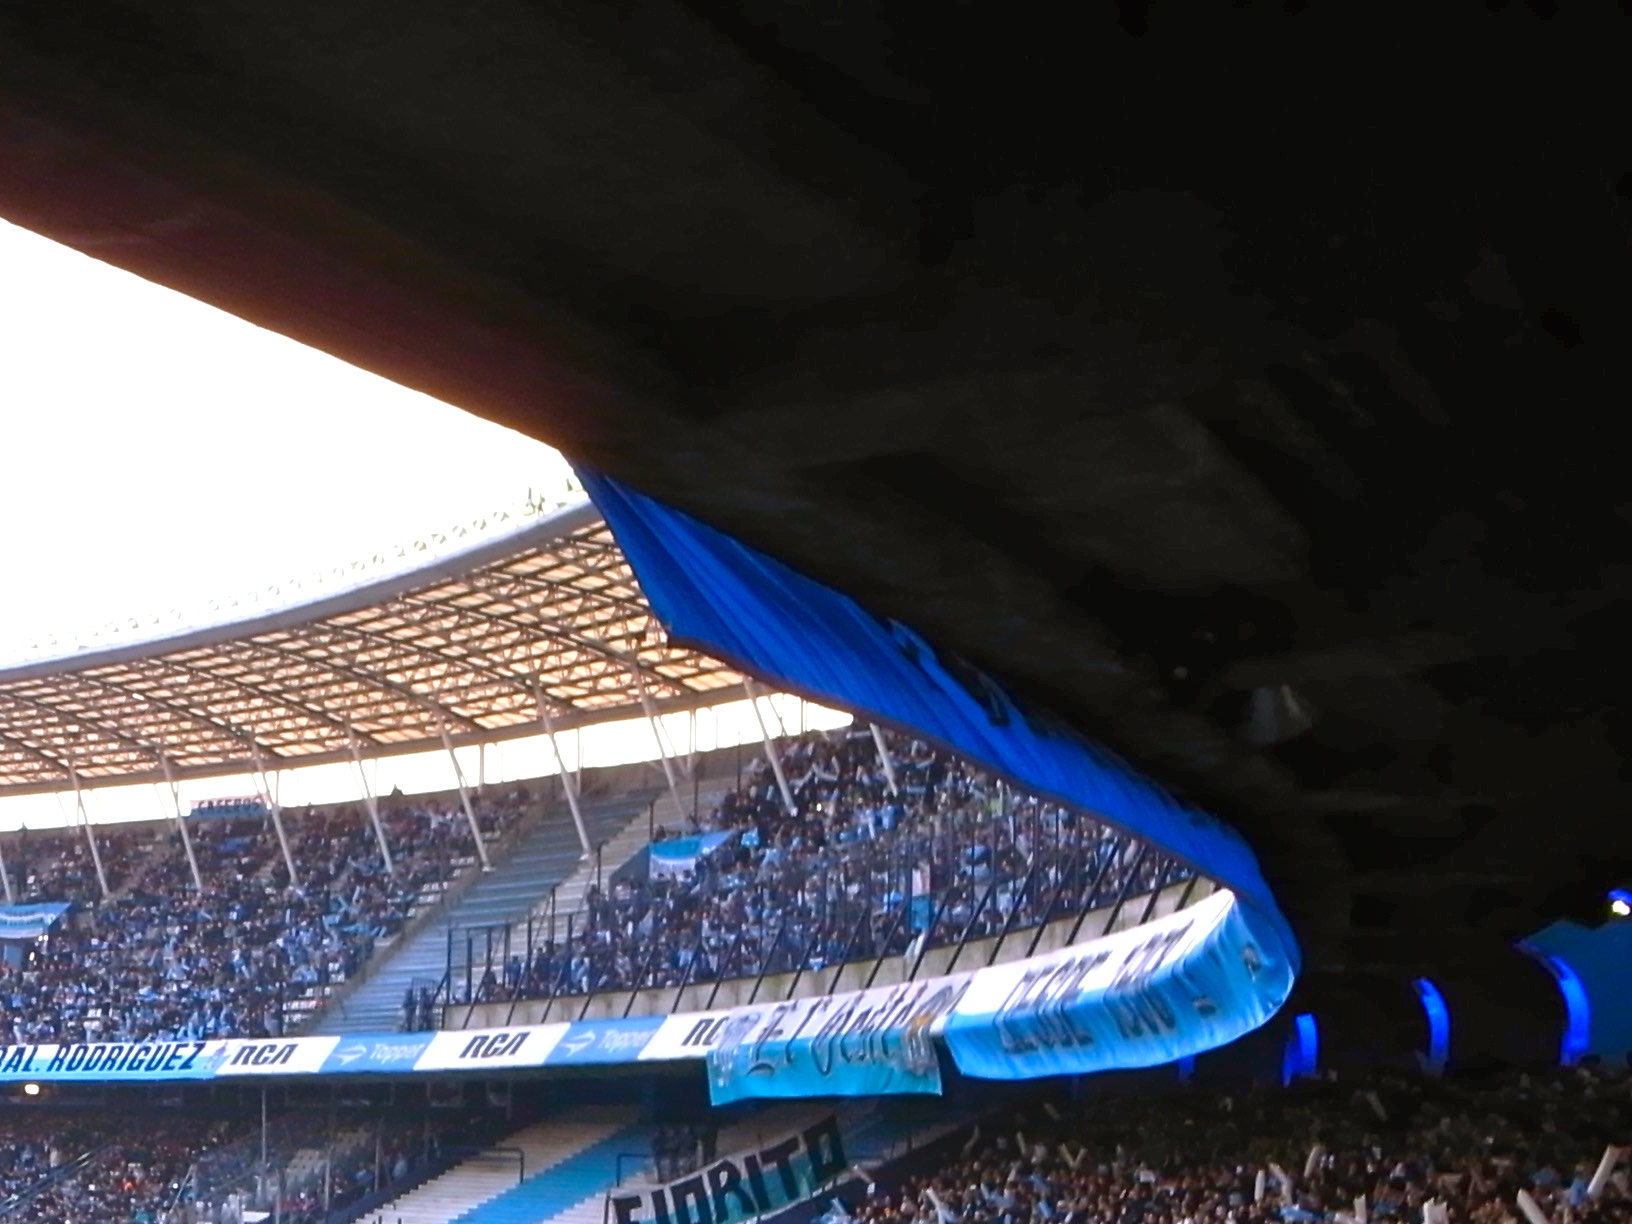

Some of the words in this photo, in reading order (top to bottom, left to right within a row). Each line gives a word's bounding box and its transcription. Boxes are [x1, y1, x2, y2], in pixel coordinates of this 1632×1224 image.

[47, 1041, 207, 1073] RODRIGUEZ
[229, 1043, 300, 1066] RCA
[458, 1031, 532, 1060] RCA
